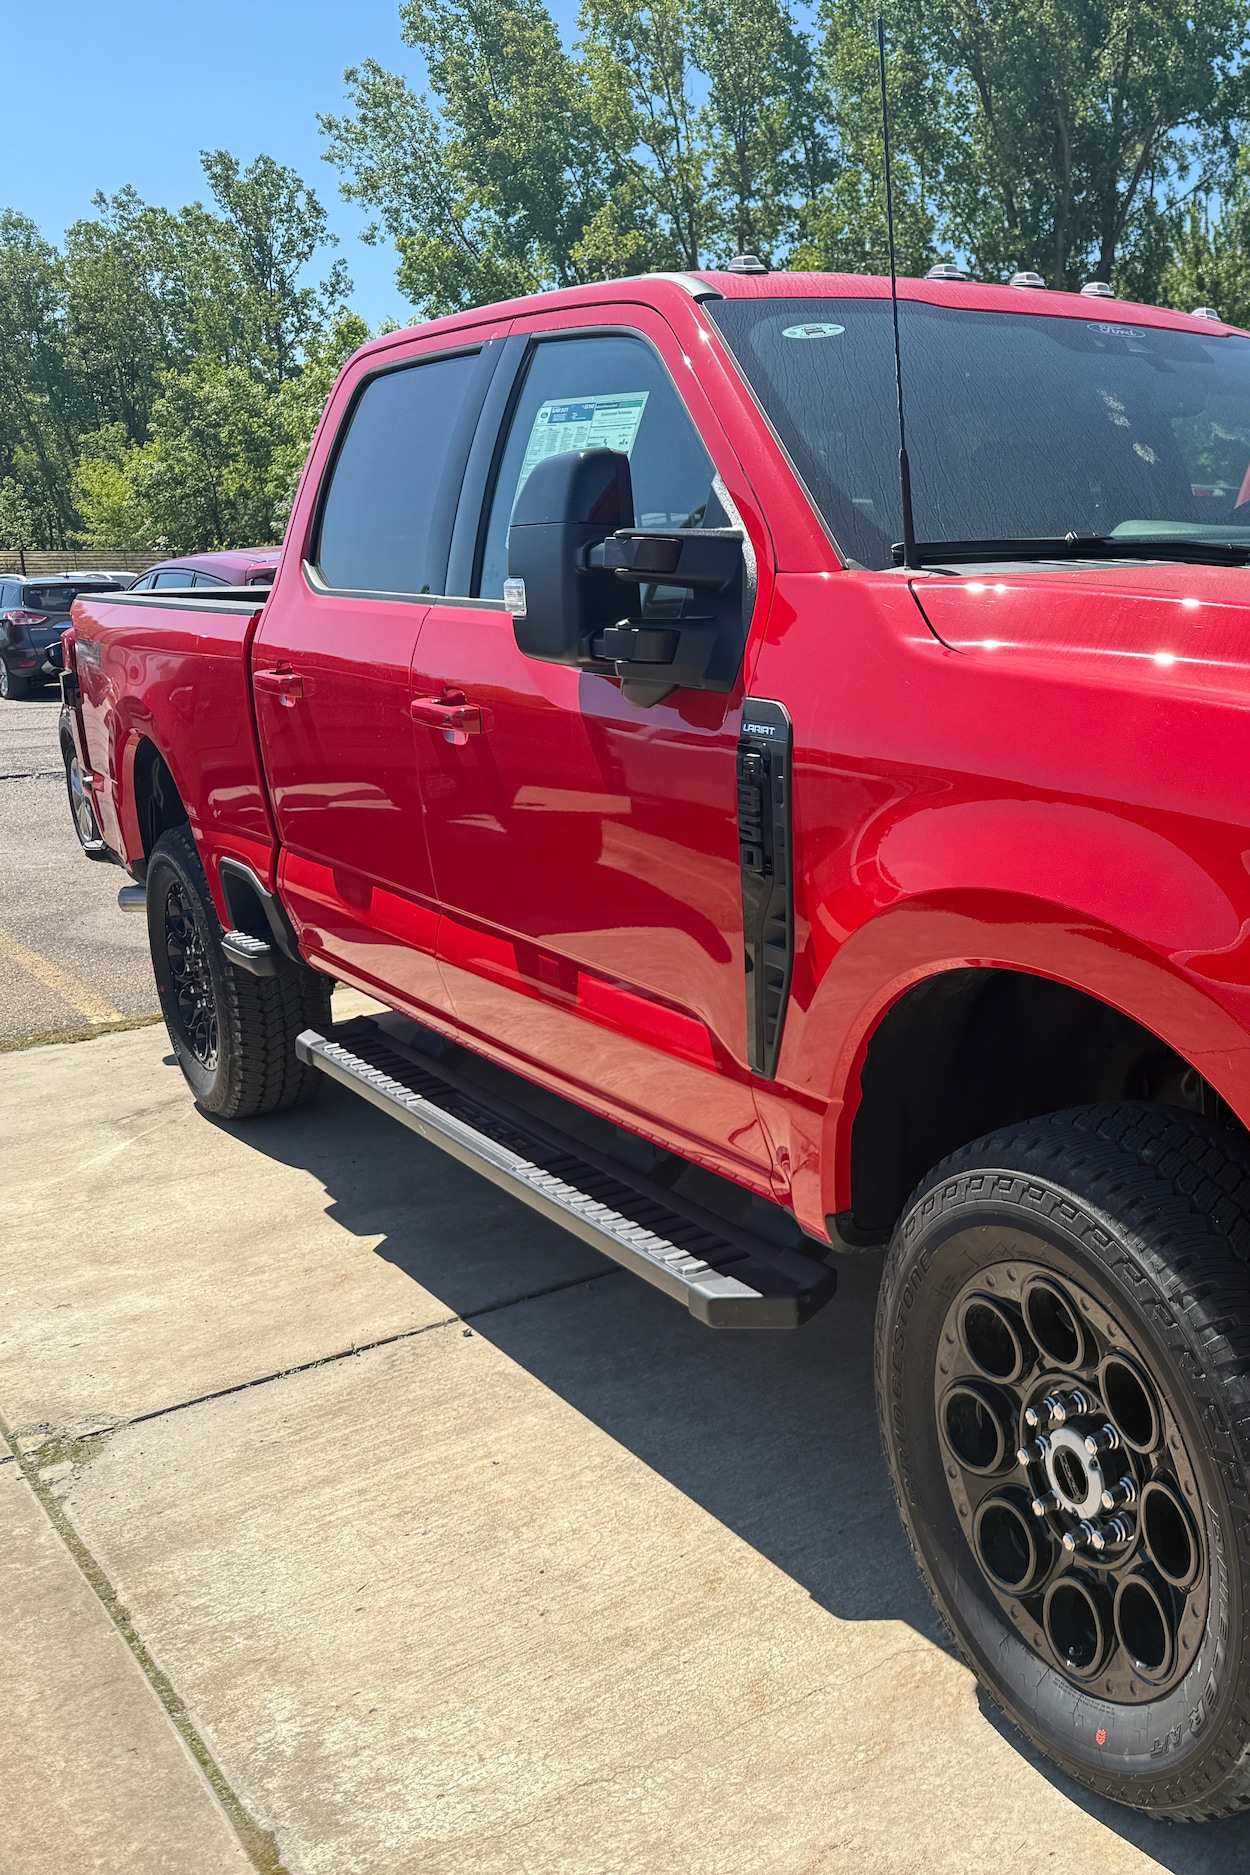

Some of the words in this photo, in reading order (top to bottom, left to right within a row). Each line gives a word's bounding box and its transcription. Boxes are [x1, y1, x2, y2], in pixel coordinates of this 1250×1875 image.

[742, 723, 776, 736] LARIAT
[890, 1252, 932, 1507] BRIDGESTONE
[1150, 1722, 1182, 1759] A/T
